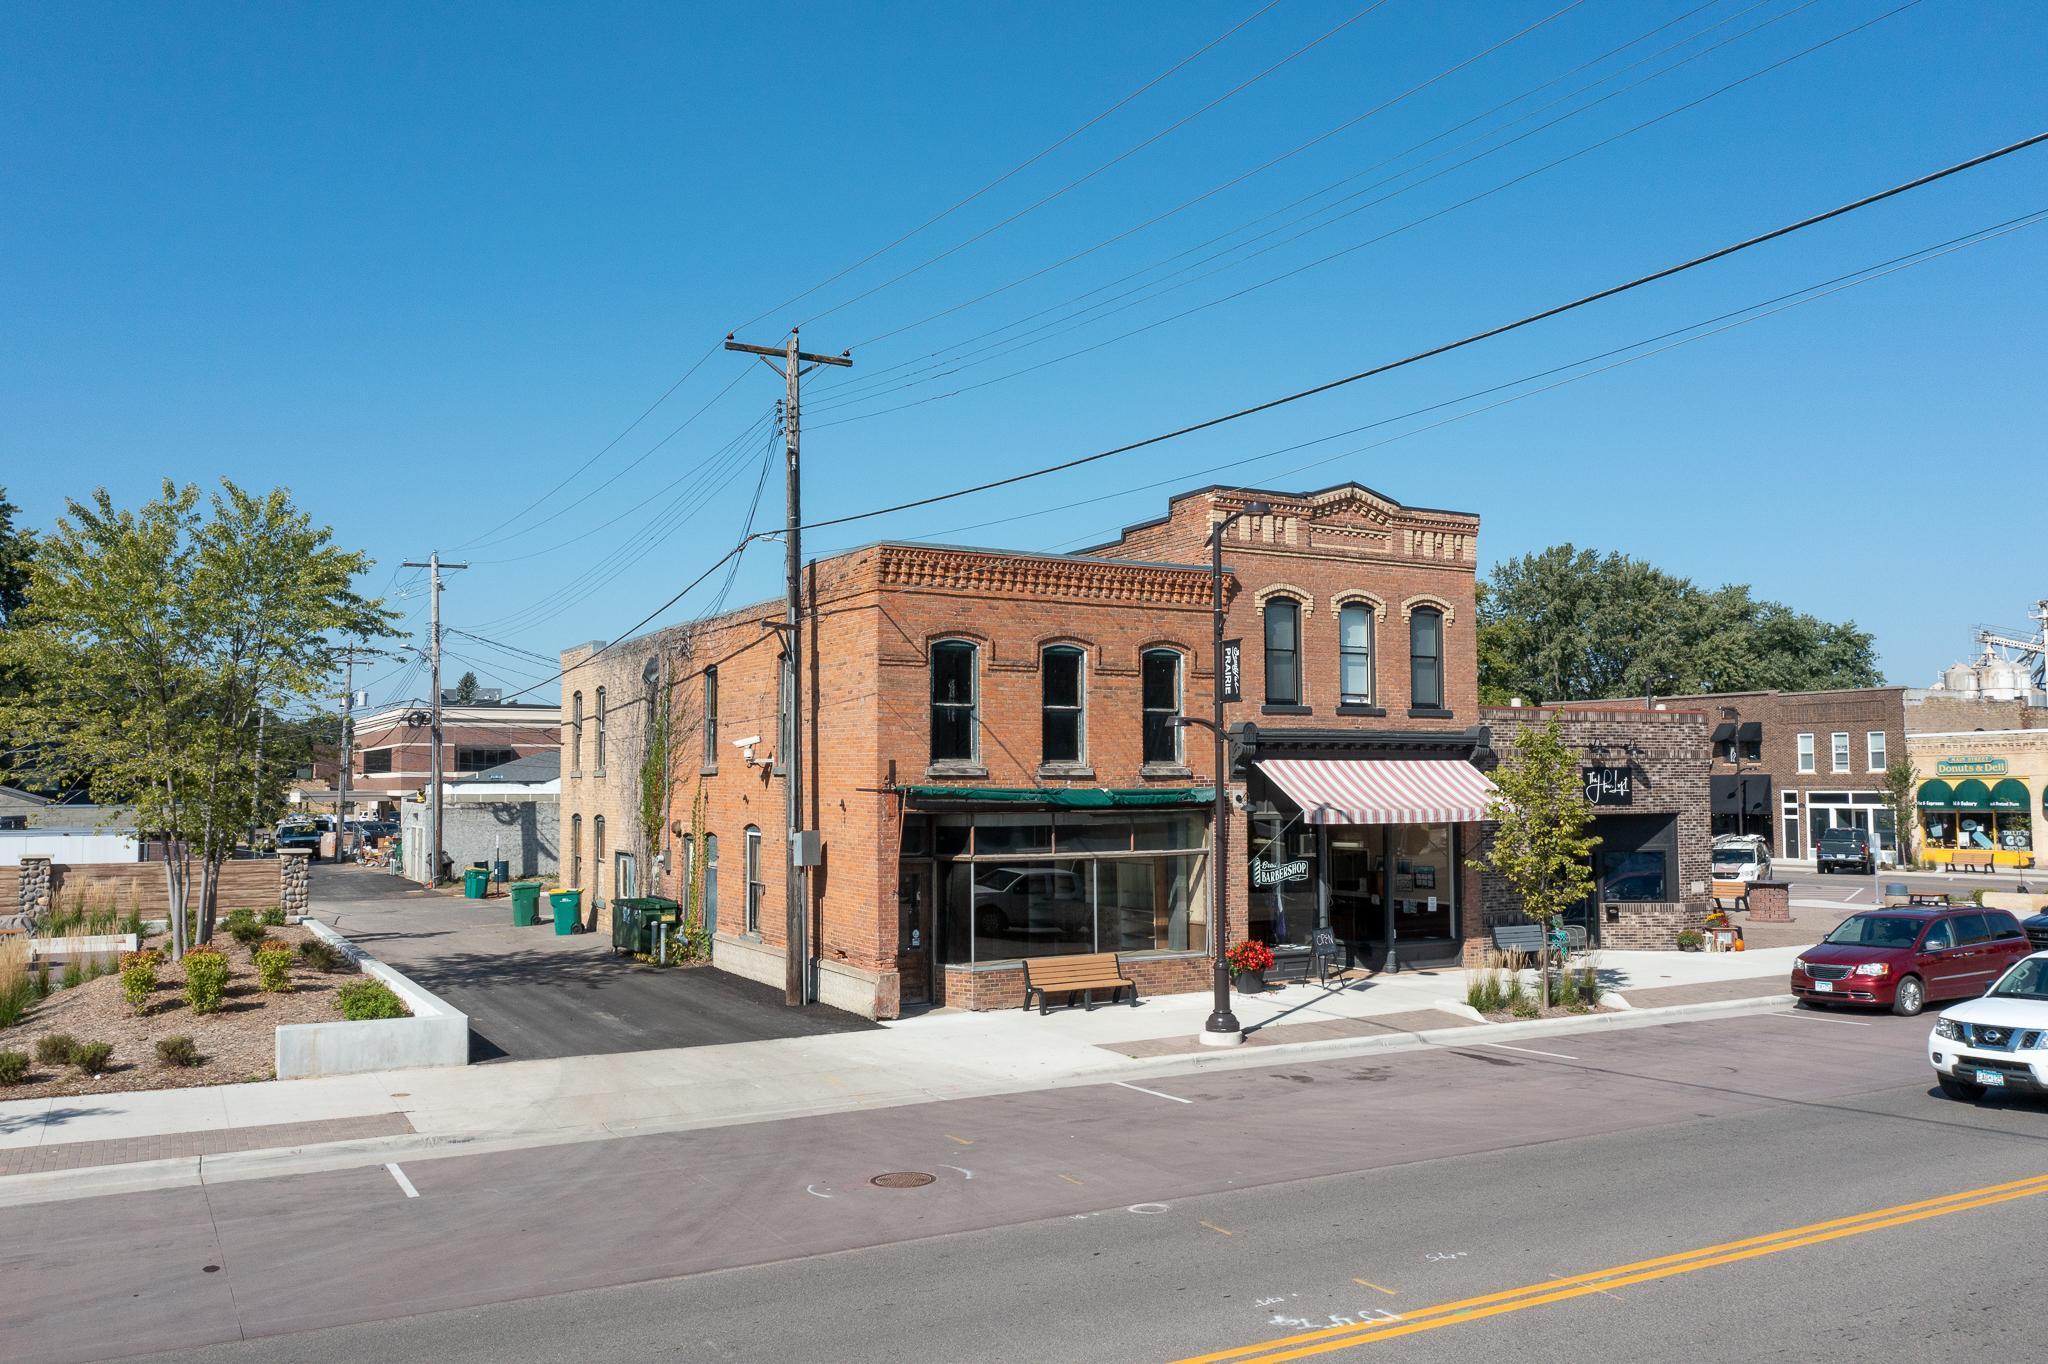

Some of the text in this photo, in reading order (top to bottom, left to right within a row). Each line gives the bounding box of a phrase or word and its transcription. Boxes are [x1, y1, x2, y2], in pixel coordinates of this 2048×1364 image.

[1938, 763, 1974, 773] Donuts
[1261, 862, 1307, 883] BARBERSHOP
[1316, 933, 1334, 946] OPEN
